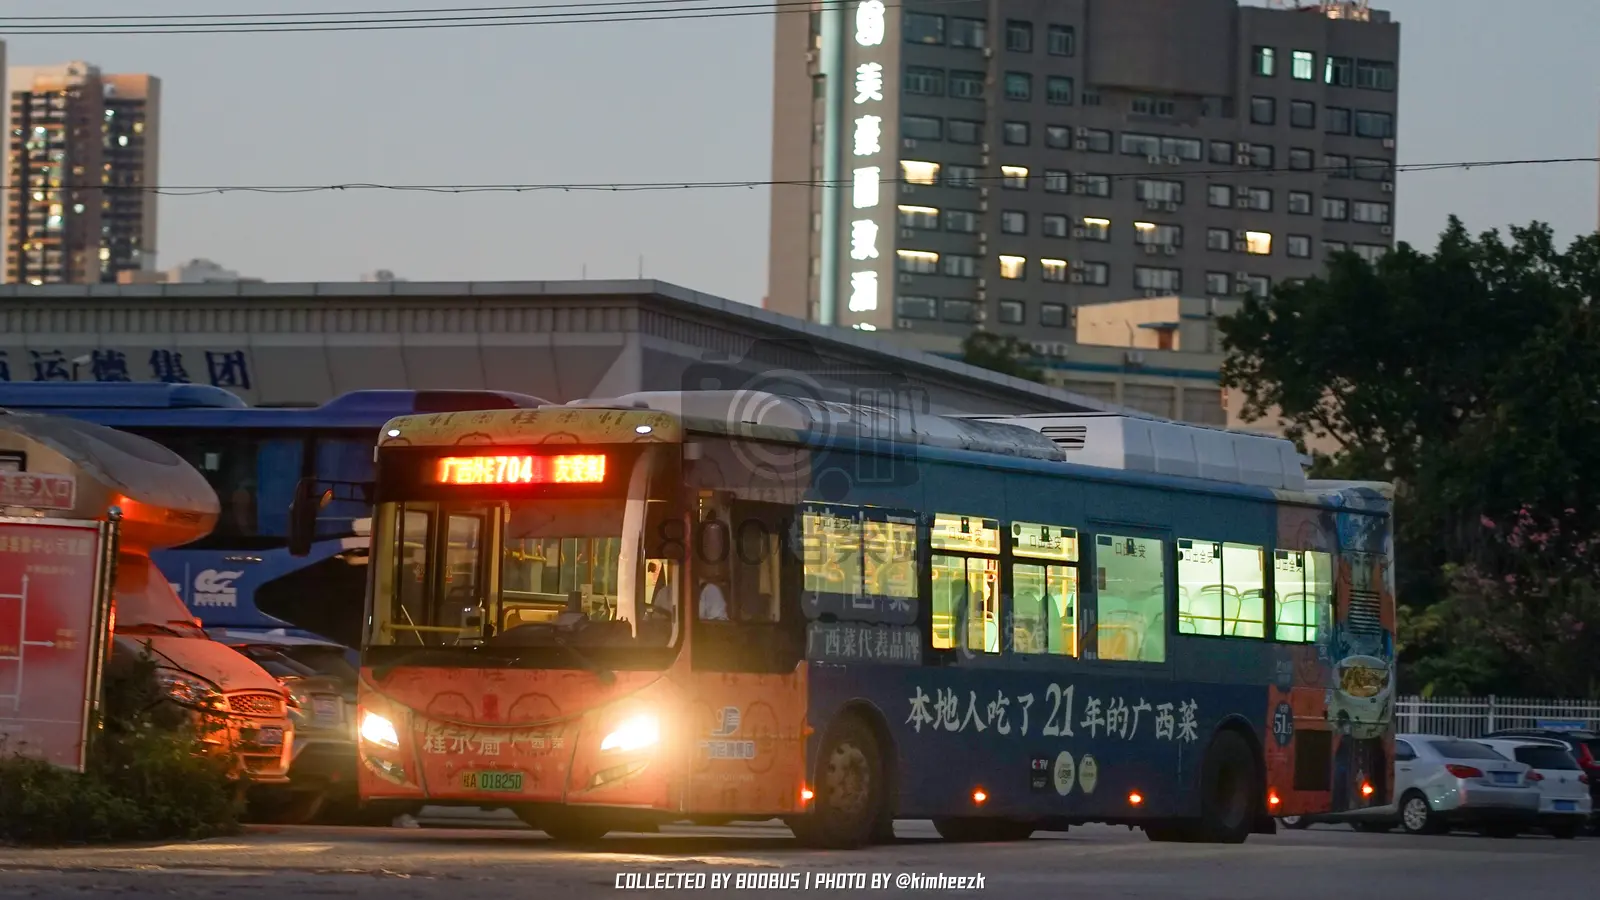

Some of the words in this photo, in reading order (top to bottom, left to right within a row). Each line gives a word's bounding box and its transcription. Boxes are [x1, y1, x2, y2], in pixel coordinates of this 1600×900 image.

[808, 627, 921, 661] 广西菜代表品牌
[904, 683, 1199, 742] 本地人吃了21年的广西菜
